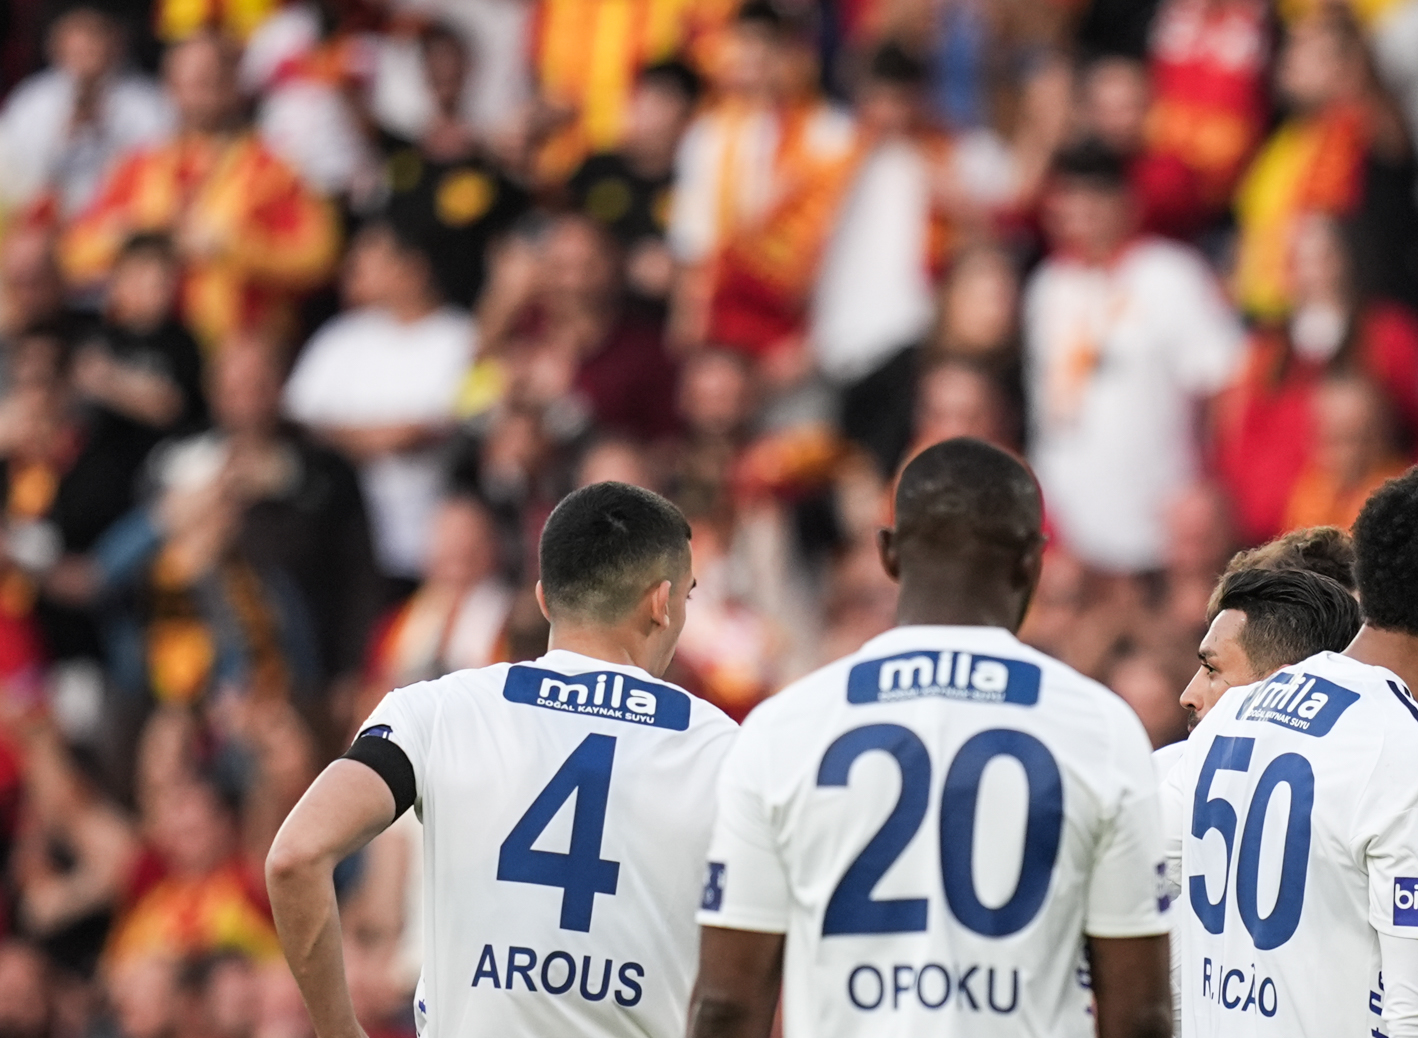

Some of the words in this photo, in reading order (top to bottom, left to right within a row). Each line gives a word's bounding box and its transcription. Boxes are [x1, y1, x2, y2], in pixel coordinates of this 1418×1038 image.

[539, 674, 657, 715] mila
[878, 650, 1009, 692] mila
[536, 697, 575, 712] DOĞAL
[577, 705, 622, 719] KAYNAK
[625, 712, 655, 724] SUYU
[1289, 717, 1311, 730] SUYU
[496, 732, 620, 933] 4
[816, 722, 1064, 940] 20
[1188, 735, 1315, 951] 50
[471, 944, 645, 1007] AROUS
[847, 963, 1019, 1015] OPOKU
